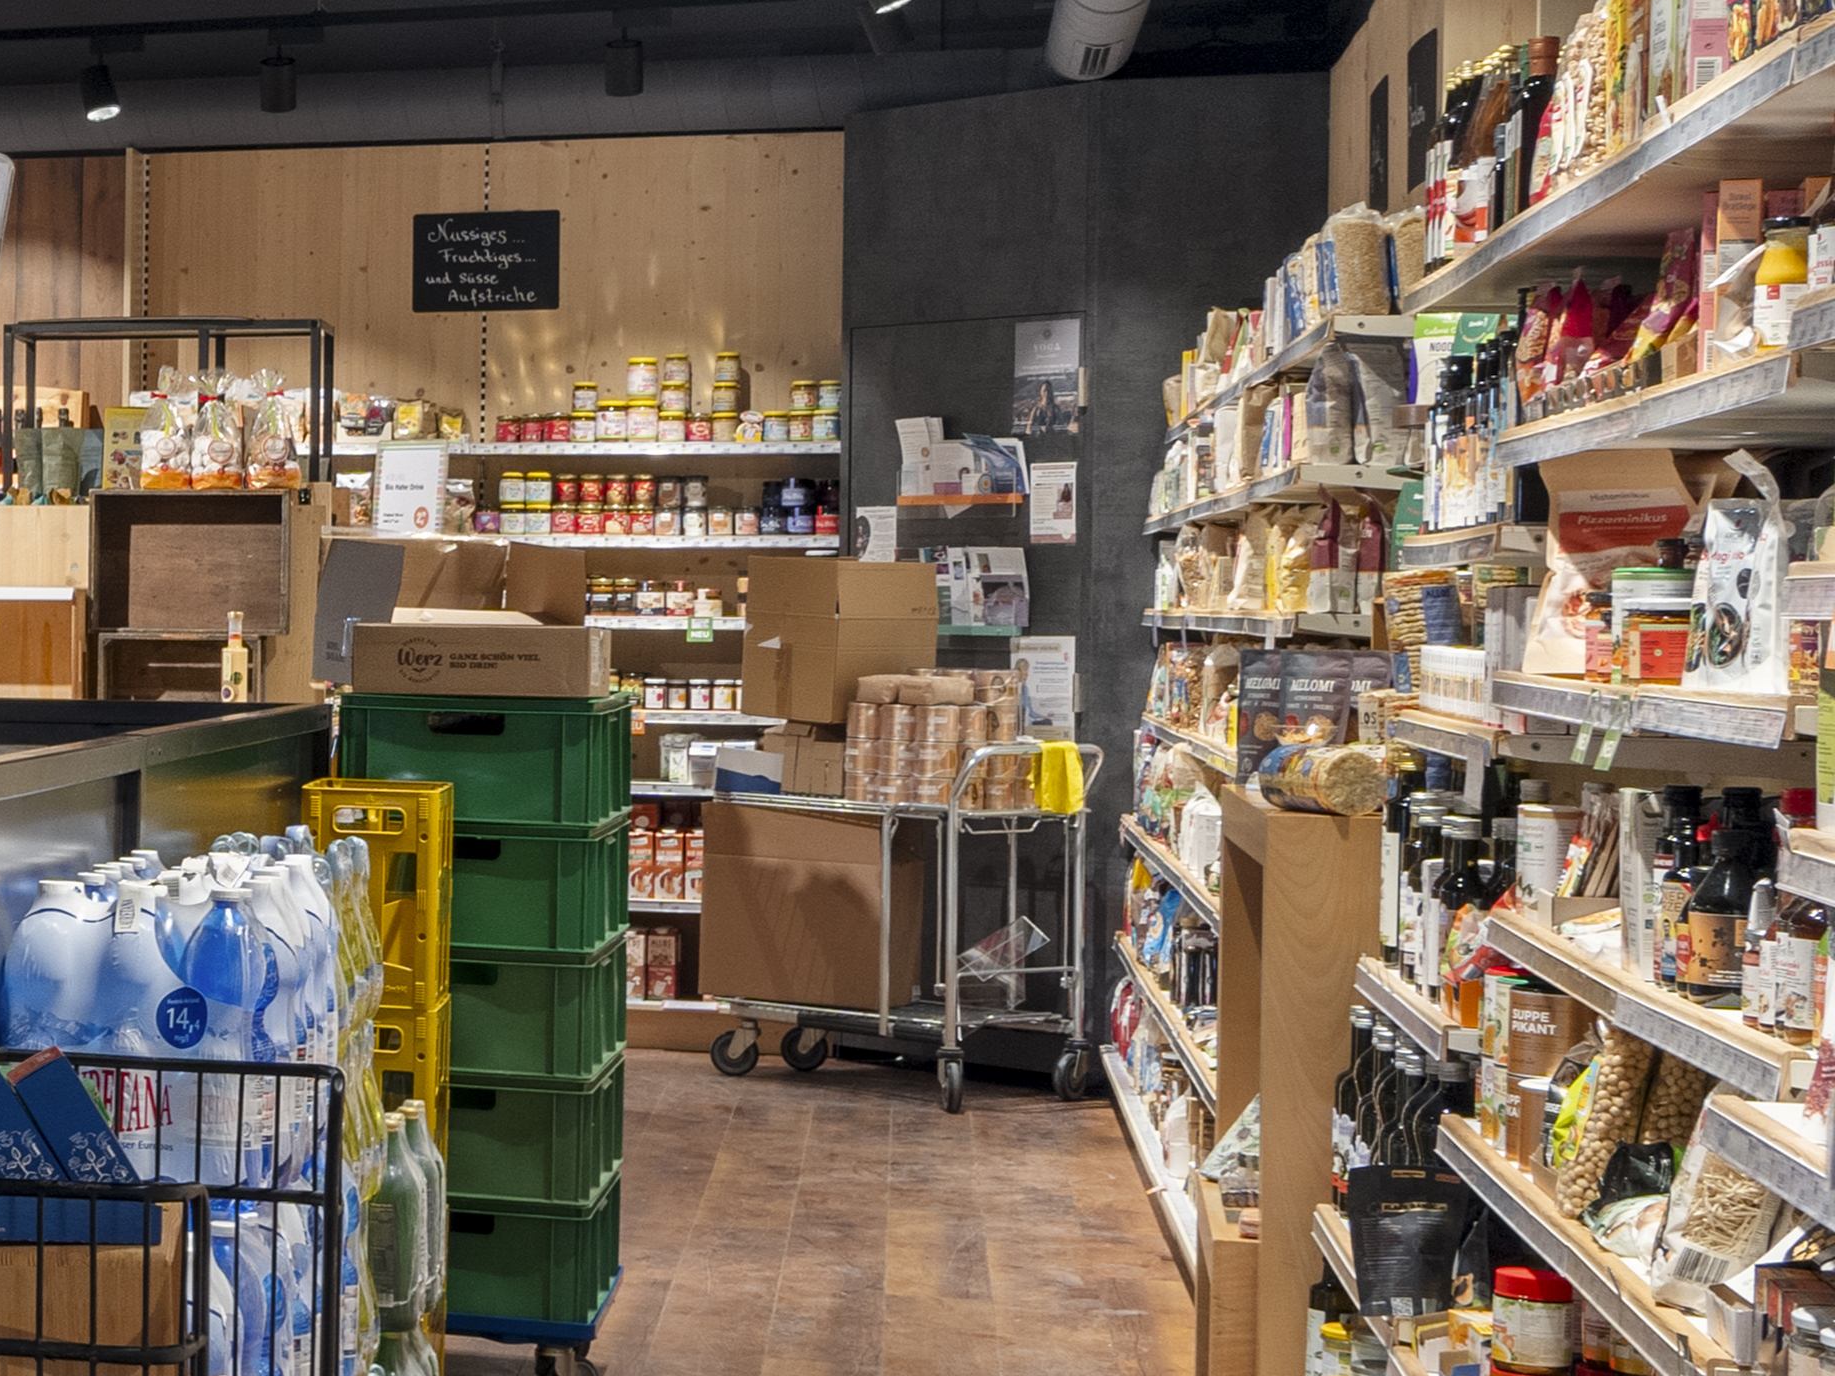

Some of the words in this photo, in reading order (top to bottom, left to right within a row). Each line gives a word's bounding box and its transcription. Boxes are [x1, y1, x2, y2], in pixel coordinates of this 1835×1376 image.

[427, 218, 507, 247] Nussiges
[425, 273, 452, 285] und
[448, 287, 537, 308] Aufstriche
[690, 630, 710, 639] NEU
[397, 647, 443, 667] Werz
[449, 653, 478, 661] GANZ
[481, 651, 515, 662] SCHÖN
[517, 653, 540, 662] VIEL
[449, 661, 467, 670] BIO
[469, 661, 498, 670] DRIN!
[1290, 679, 1336, 693] MELOMI
[1512, 1009, 1550, 1022] SUPPE
[1512, 1021, 1557, 1036] PIKANT
